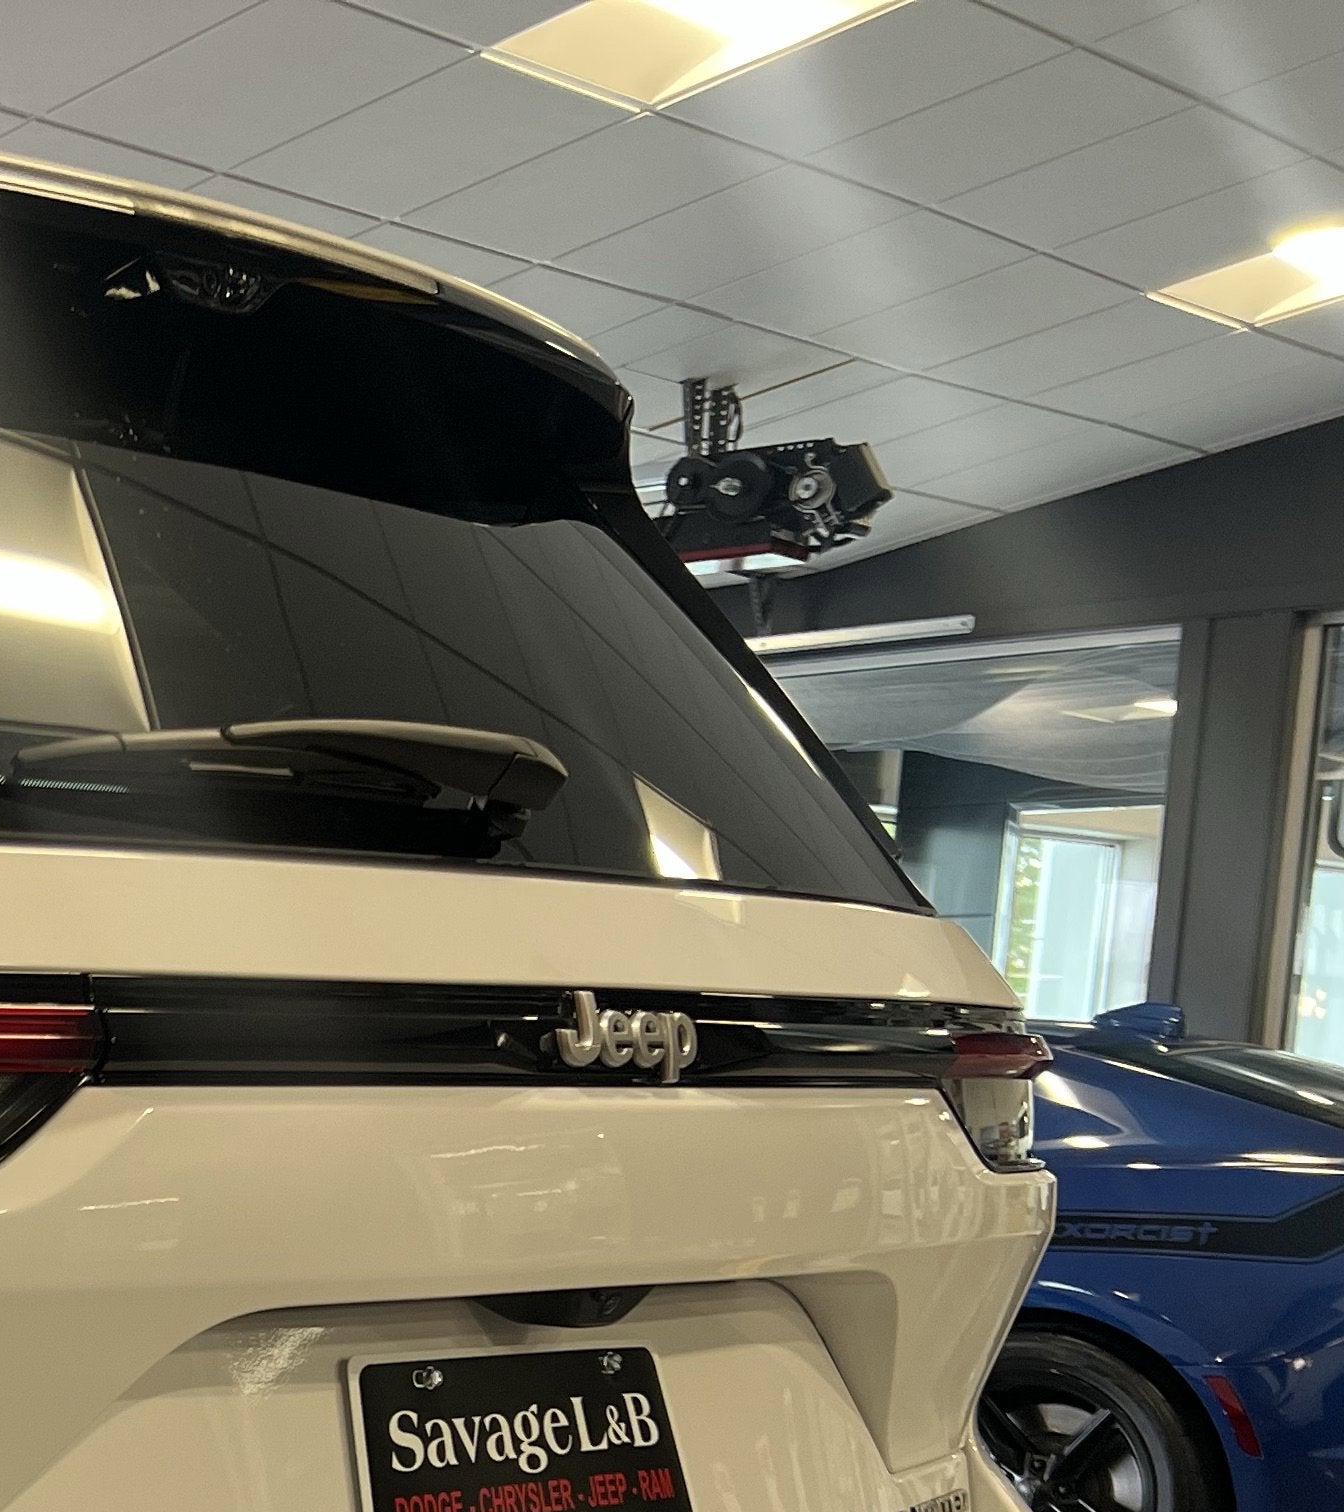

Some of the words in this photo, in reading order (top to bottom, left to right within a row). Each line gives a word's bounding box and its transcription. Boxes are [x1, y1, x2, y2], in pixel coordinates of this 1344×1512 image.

[556, 990, 698, 1084] Jeep
[1054, 1222, 1218, 1245] XORCIST
[587, 1471, 628, 1508] JEEP
[637, 1468, 676, 1502] RAM
